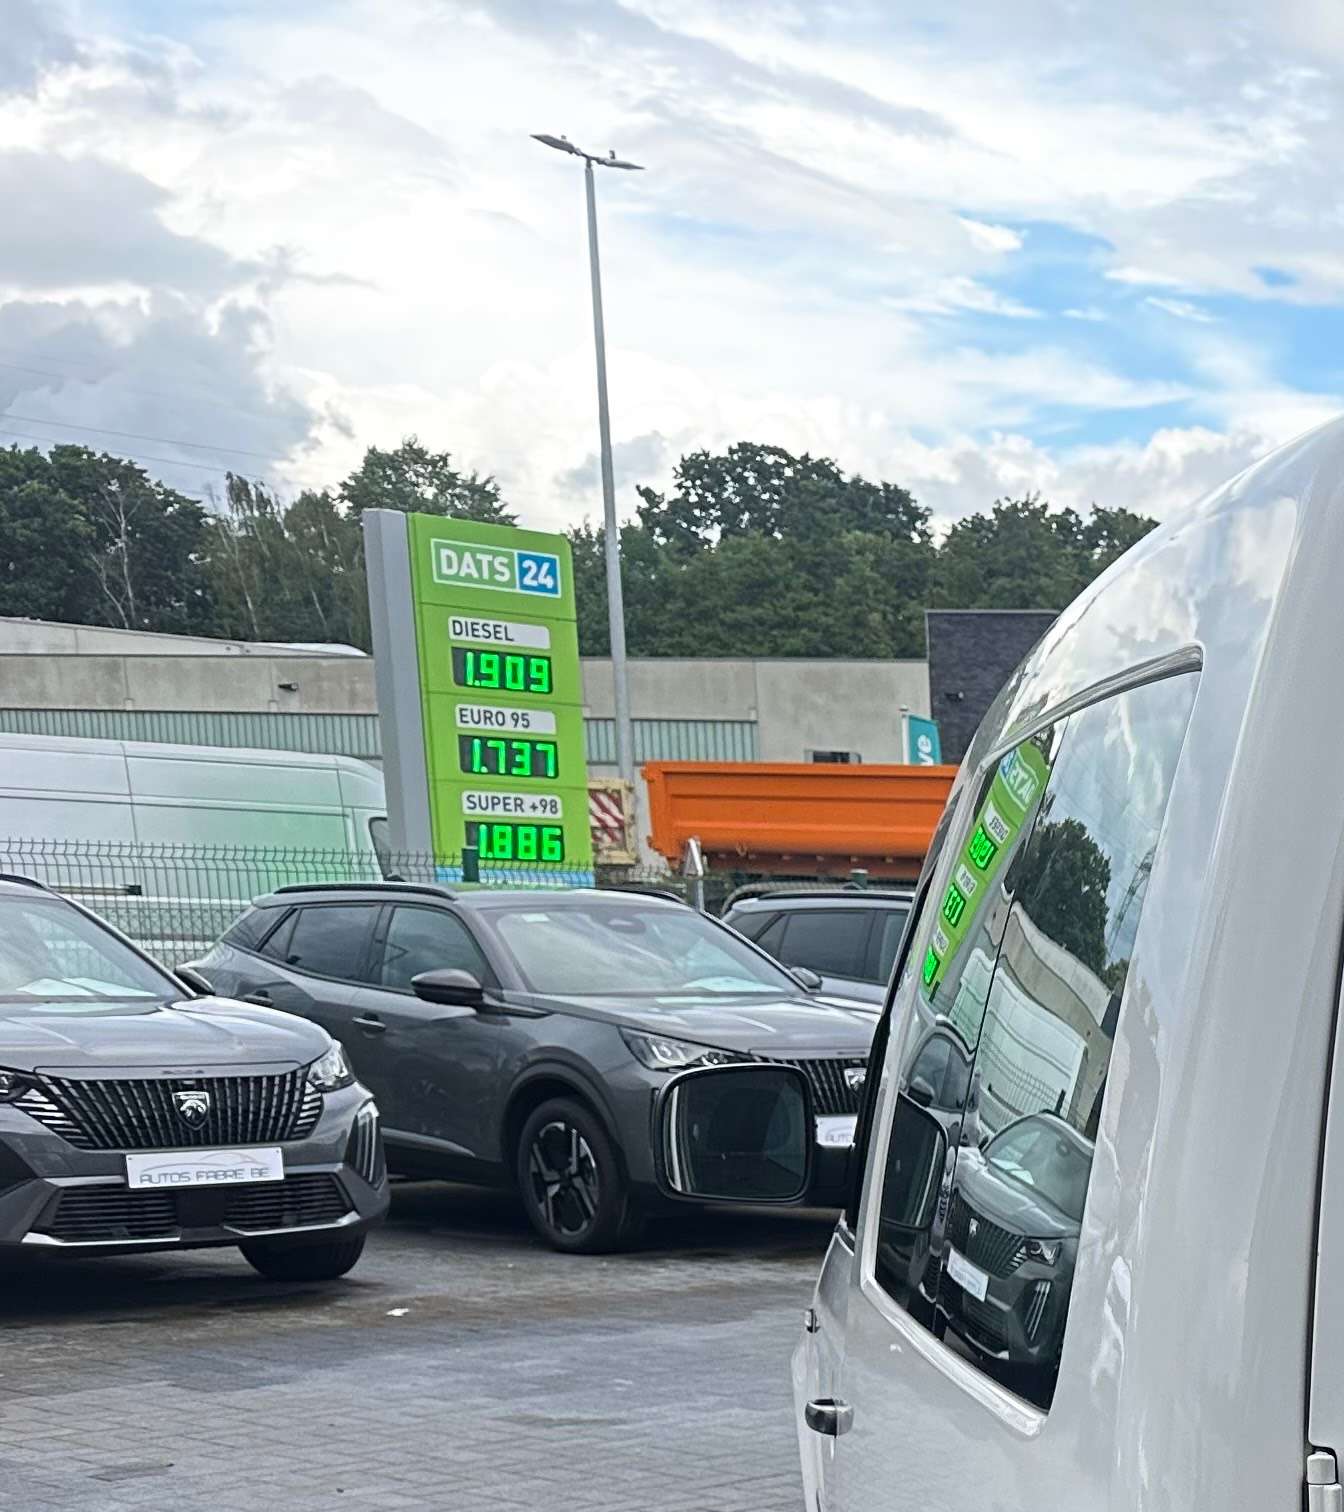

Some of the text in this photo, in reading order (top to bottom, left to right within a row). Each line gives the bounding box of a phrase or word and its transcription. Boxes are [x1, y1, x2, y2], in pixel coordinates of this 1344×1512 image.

[440, 548, 554, 589] DATS 24
[452, 619, 515, 642] DIESEL
[466, 651, 549, 692] 1.909
[459, 708, 530, 729] EURO 95
[472, 738, 555, 777] 1.737
[466, 794, 559, 815] SUPER +98
[479, 824, 561, 861] 1.886
[140, 1172, 191, 1184] AUTOS
[196, 1169, 245, 1181] FABRE
